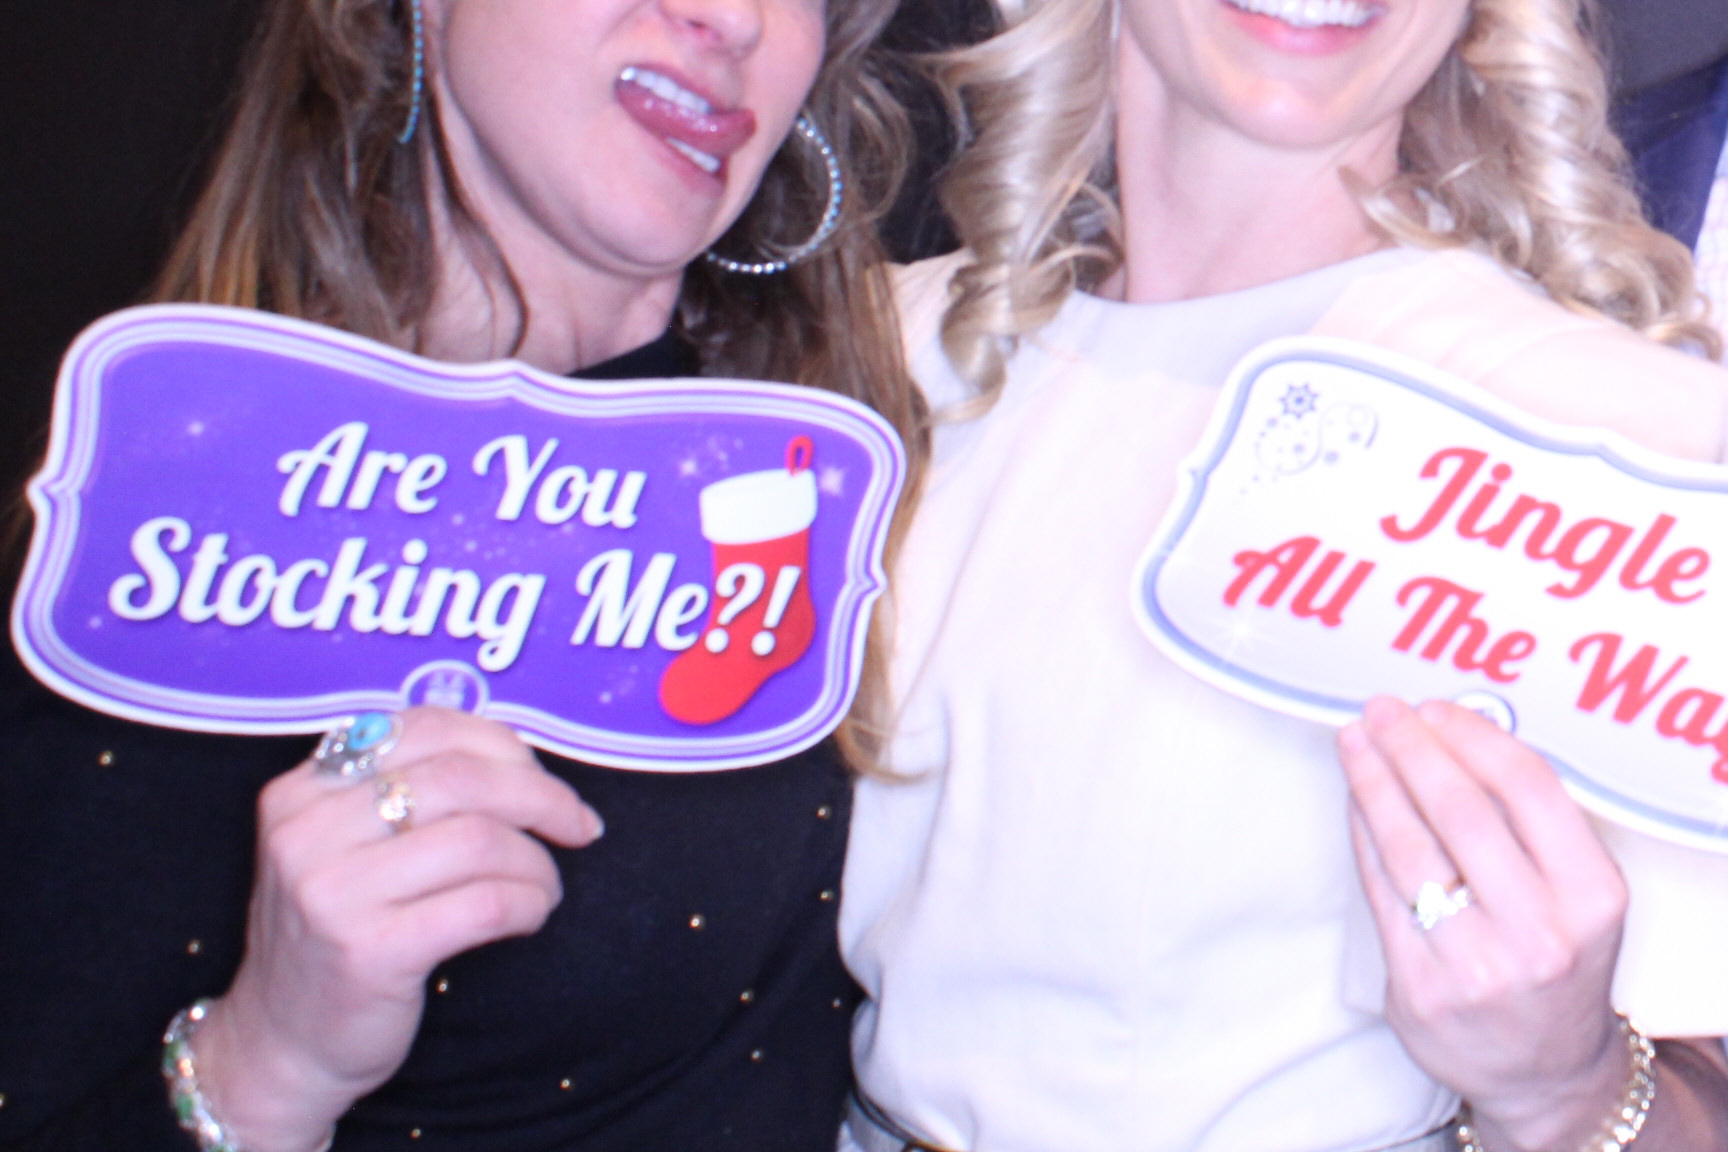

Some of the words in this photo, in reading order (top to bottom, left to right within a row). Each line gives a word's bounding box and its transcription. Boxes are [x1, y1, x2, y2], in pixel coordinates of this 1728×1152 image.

[276, 420, 448, 516] Are
[472, 434, 648, 529] You
[1379, 446, 1712, 605] Jingle
[108, 516, 548, 673] Stocking
[570, 547, 802, 657] Me?!
[1222, 535, 1376, 628] All
[1391, 576, 1538, 683] The
